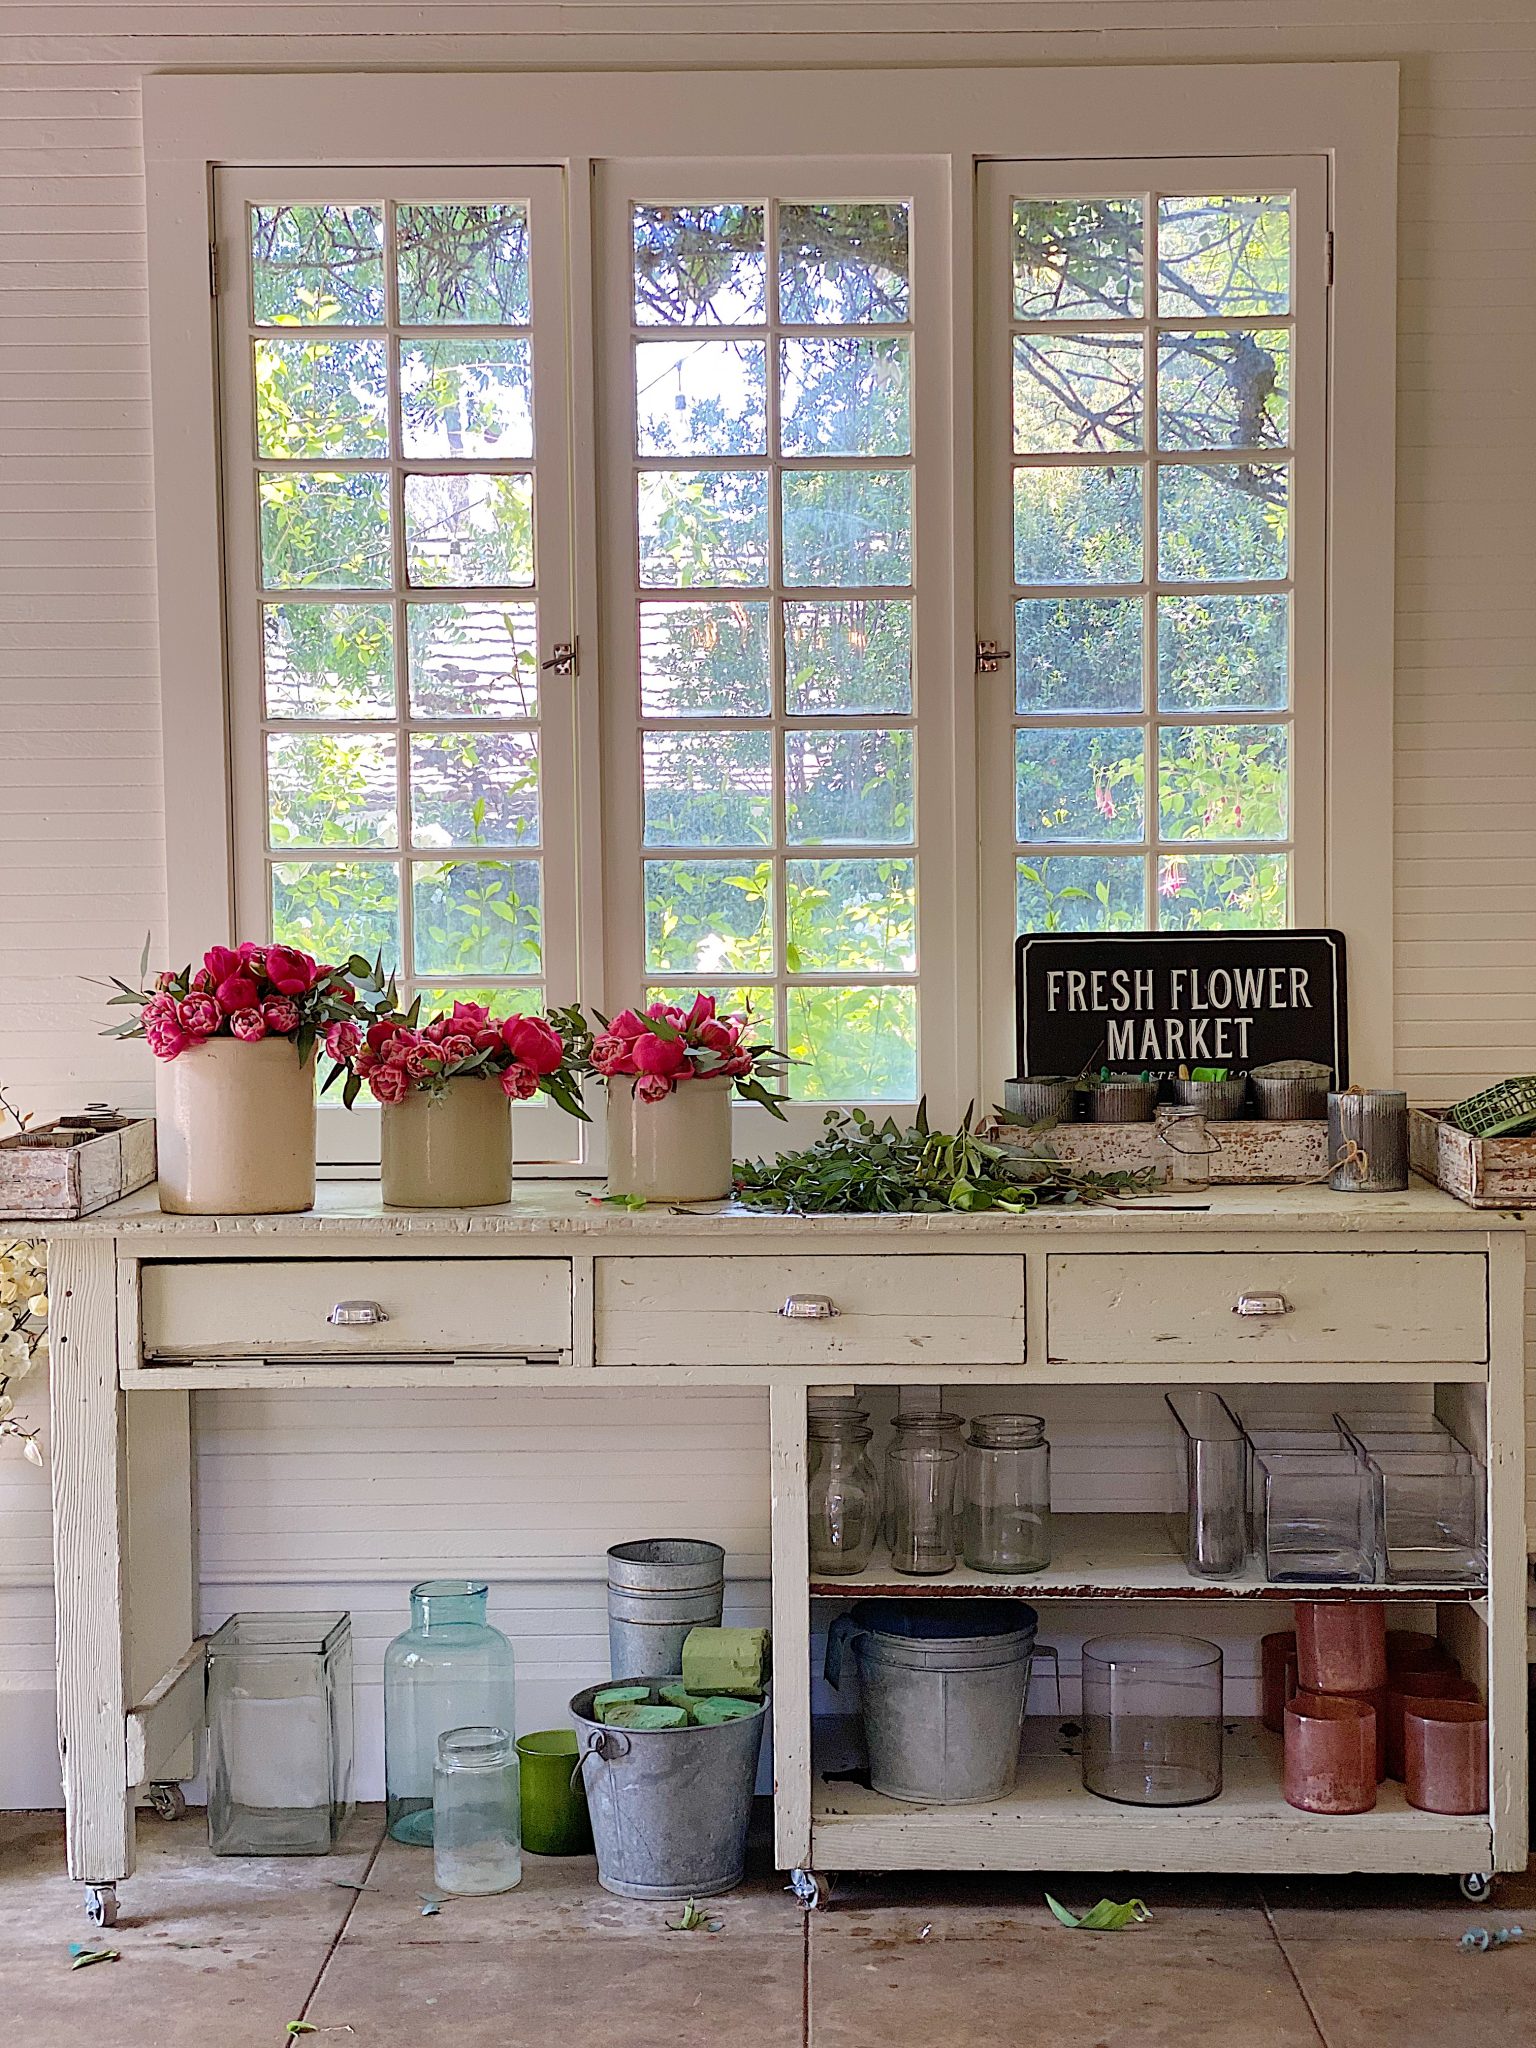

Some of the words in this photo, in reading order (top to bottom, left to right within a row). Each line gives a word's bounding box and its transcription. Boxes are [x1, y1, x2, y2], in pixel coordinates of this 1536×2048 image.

[1046, 969, 1154, 1012] FRESH
[1170, 967, 1313, 1010] FLOWER
[1107, 1017, 1254, 1061] MARKET
